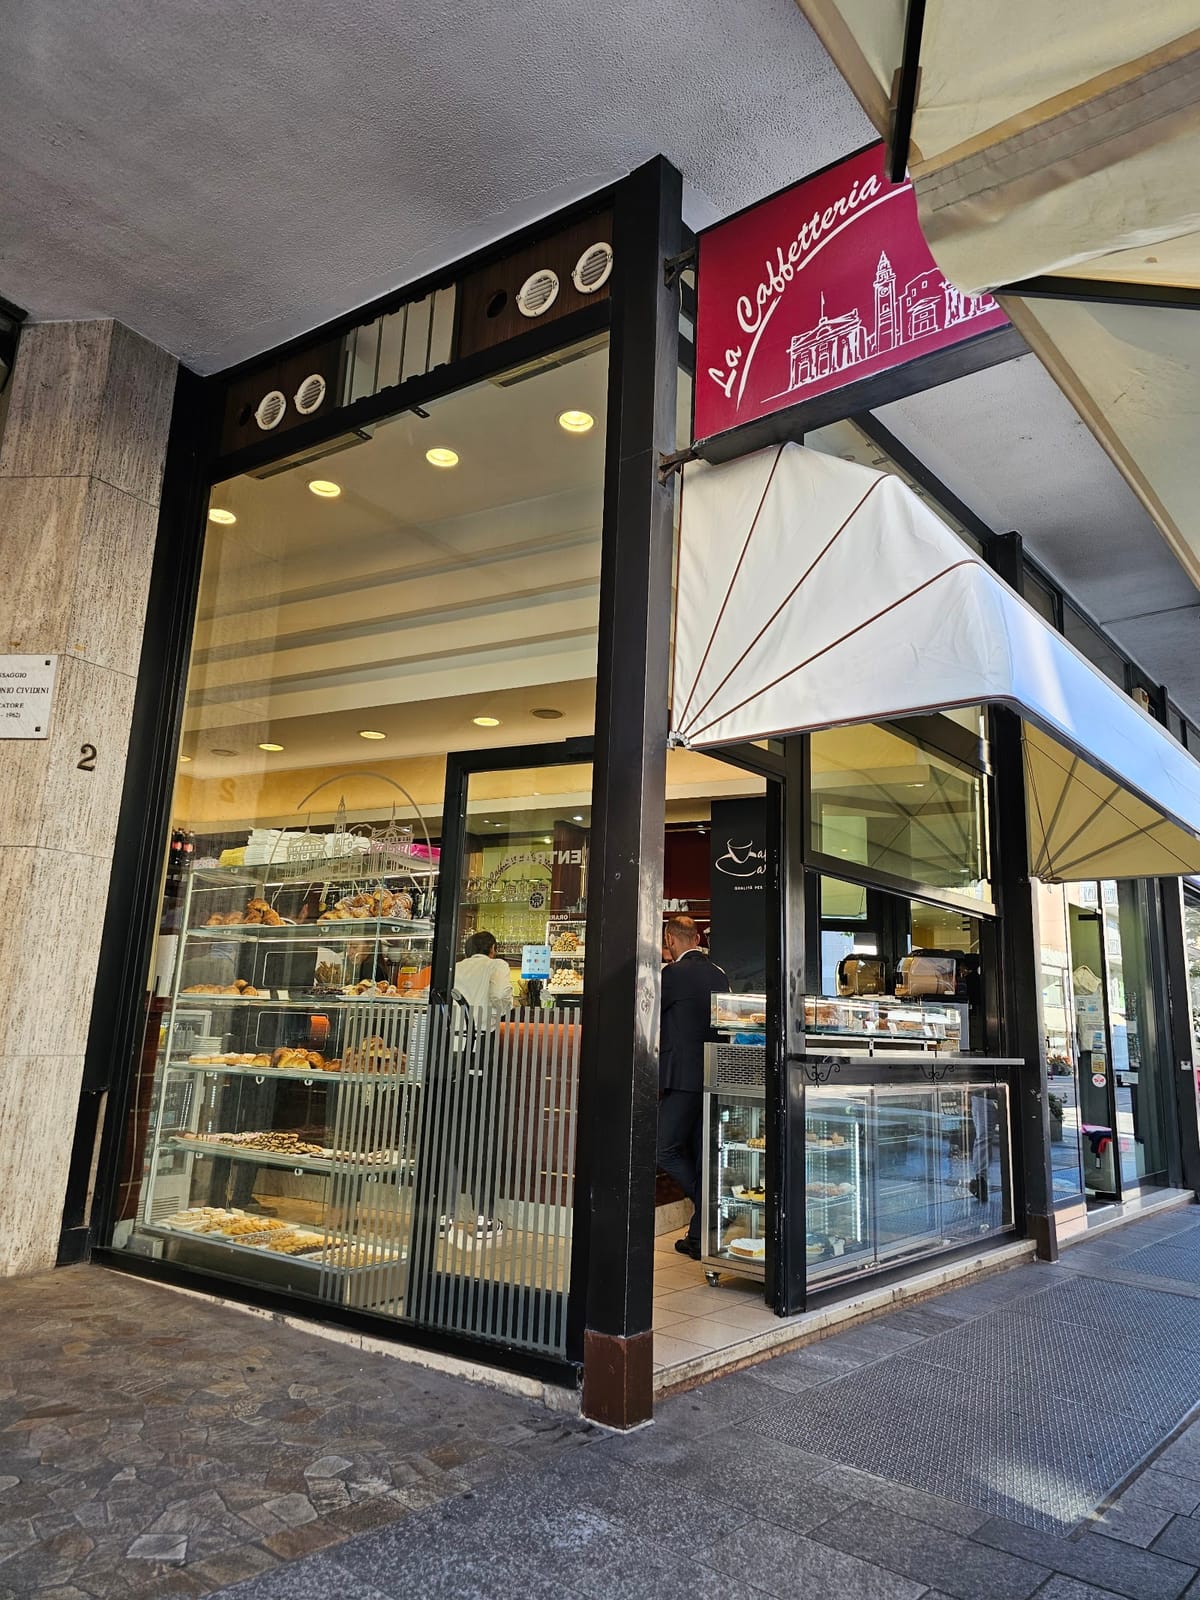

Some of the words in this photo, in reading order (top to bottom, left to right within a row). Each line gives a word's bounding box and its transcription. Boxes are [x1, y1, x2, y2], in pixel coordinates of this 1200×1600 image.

[707, 345, 742, 399] La
[736, 173, 883, 333] Caffetteria
[76, 743, 97, 771] 2
